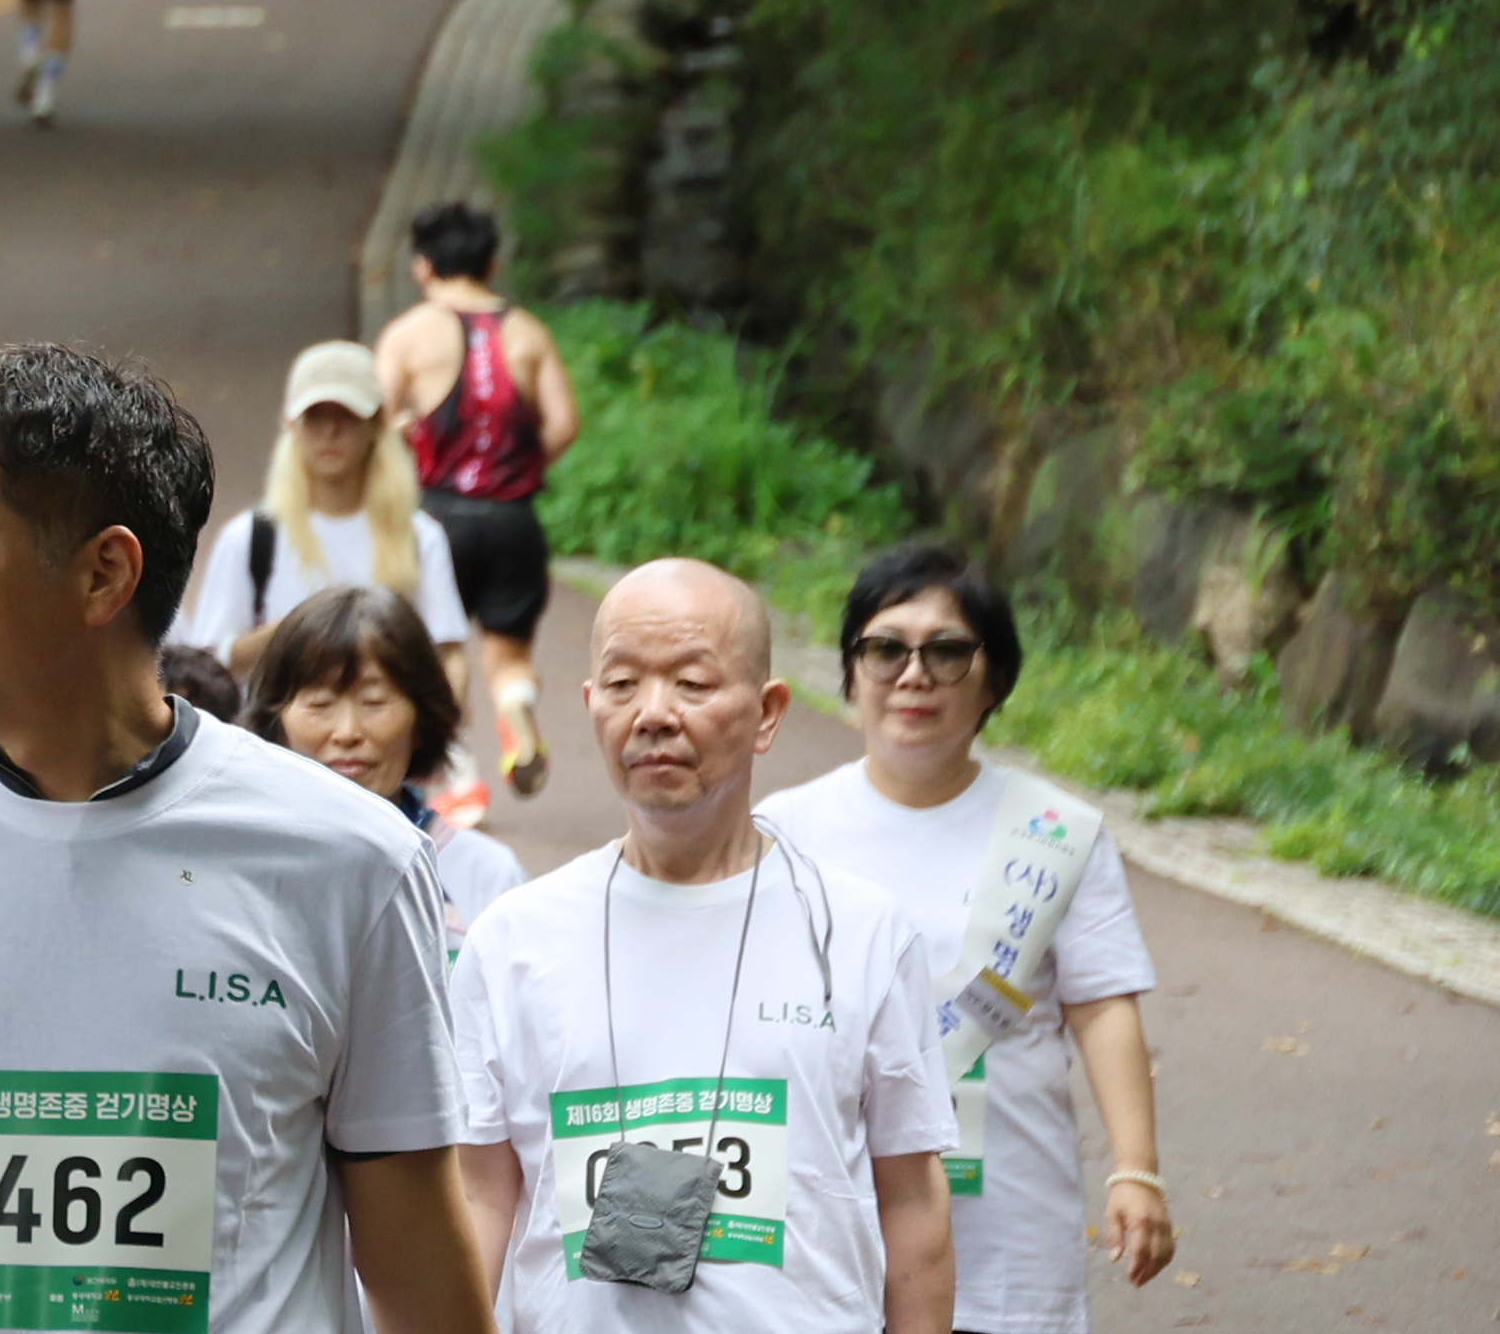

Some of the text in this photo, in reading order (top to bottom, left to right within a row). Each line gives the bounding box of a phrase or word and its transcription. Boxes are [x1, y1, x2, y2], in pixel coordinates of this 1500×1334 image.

[176, 969, 288, 1009] L.I.S.A
[758, 1001, 837, 1034] L.I.S.A
[95, 1092, 198, 1123] 걷기명상
[566, 1090, 774, 1126] 제16회 생명존중 걷기명상
